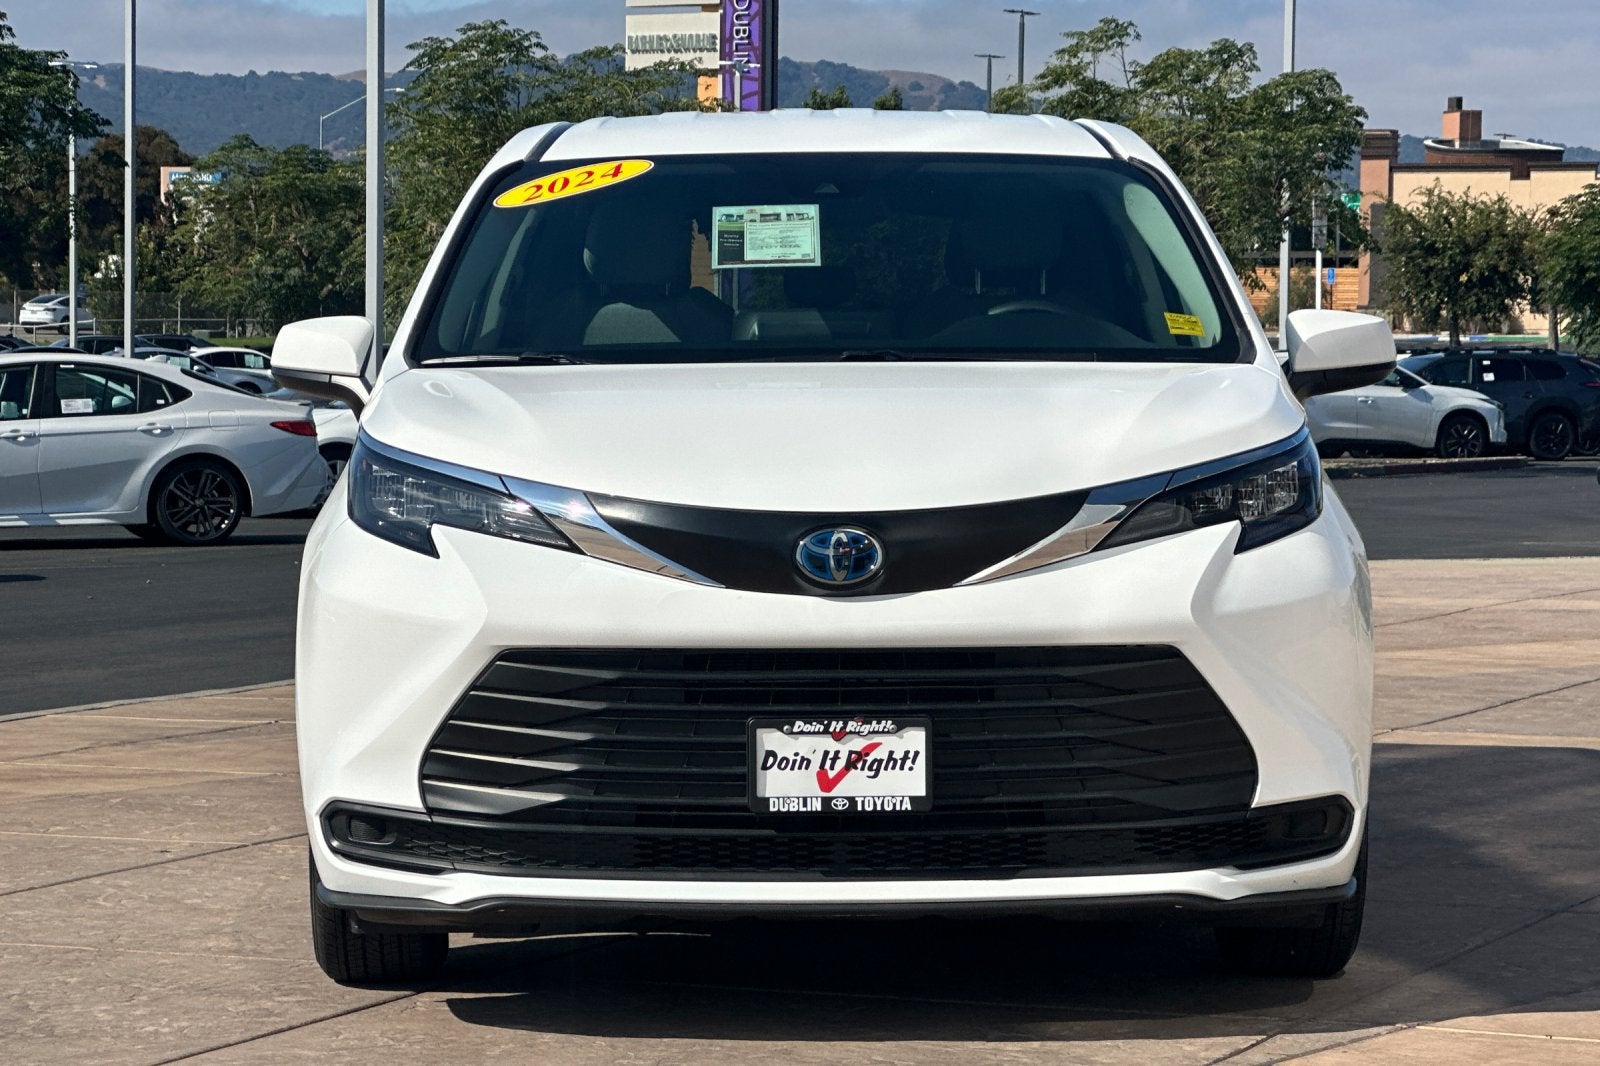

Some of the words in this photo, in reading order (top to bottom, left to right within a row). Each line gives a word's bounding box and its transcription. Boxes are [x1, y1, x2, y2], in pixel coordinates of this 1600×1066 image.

[522, 162, 624, 203] 2024
[829, 720, 845, 733] It
[760, 749, 817, 771] Doin'
[819, 749, 841, 771] It
[844, 749, 921, 779] Right!
[769, 797, 822, 812] DUBLIN
[855, 796, 912, 811] TOYOTA
